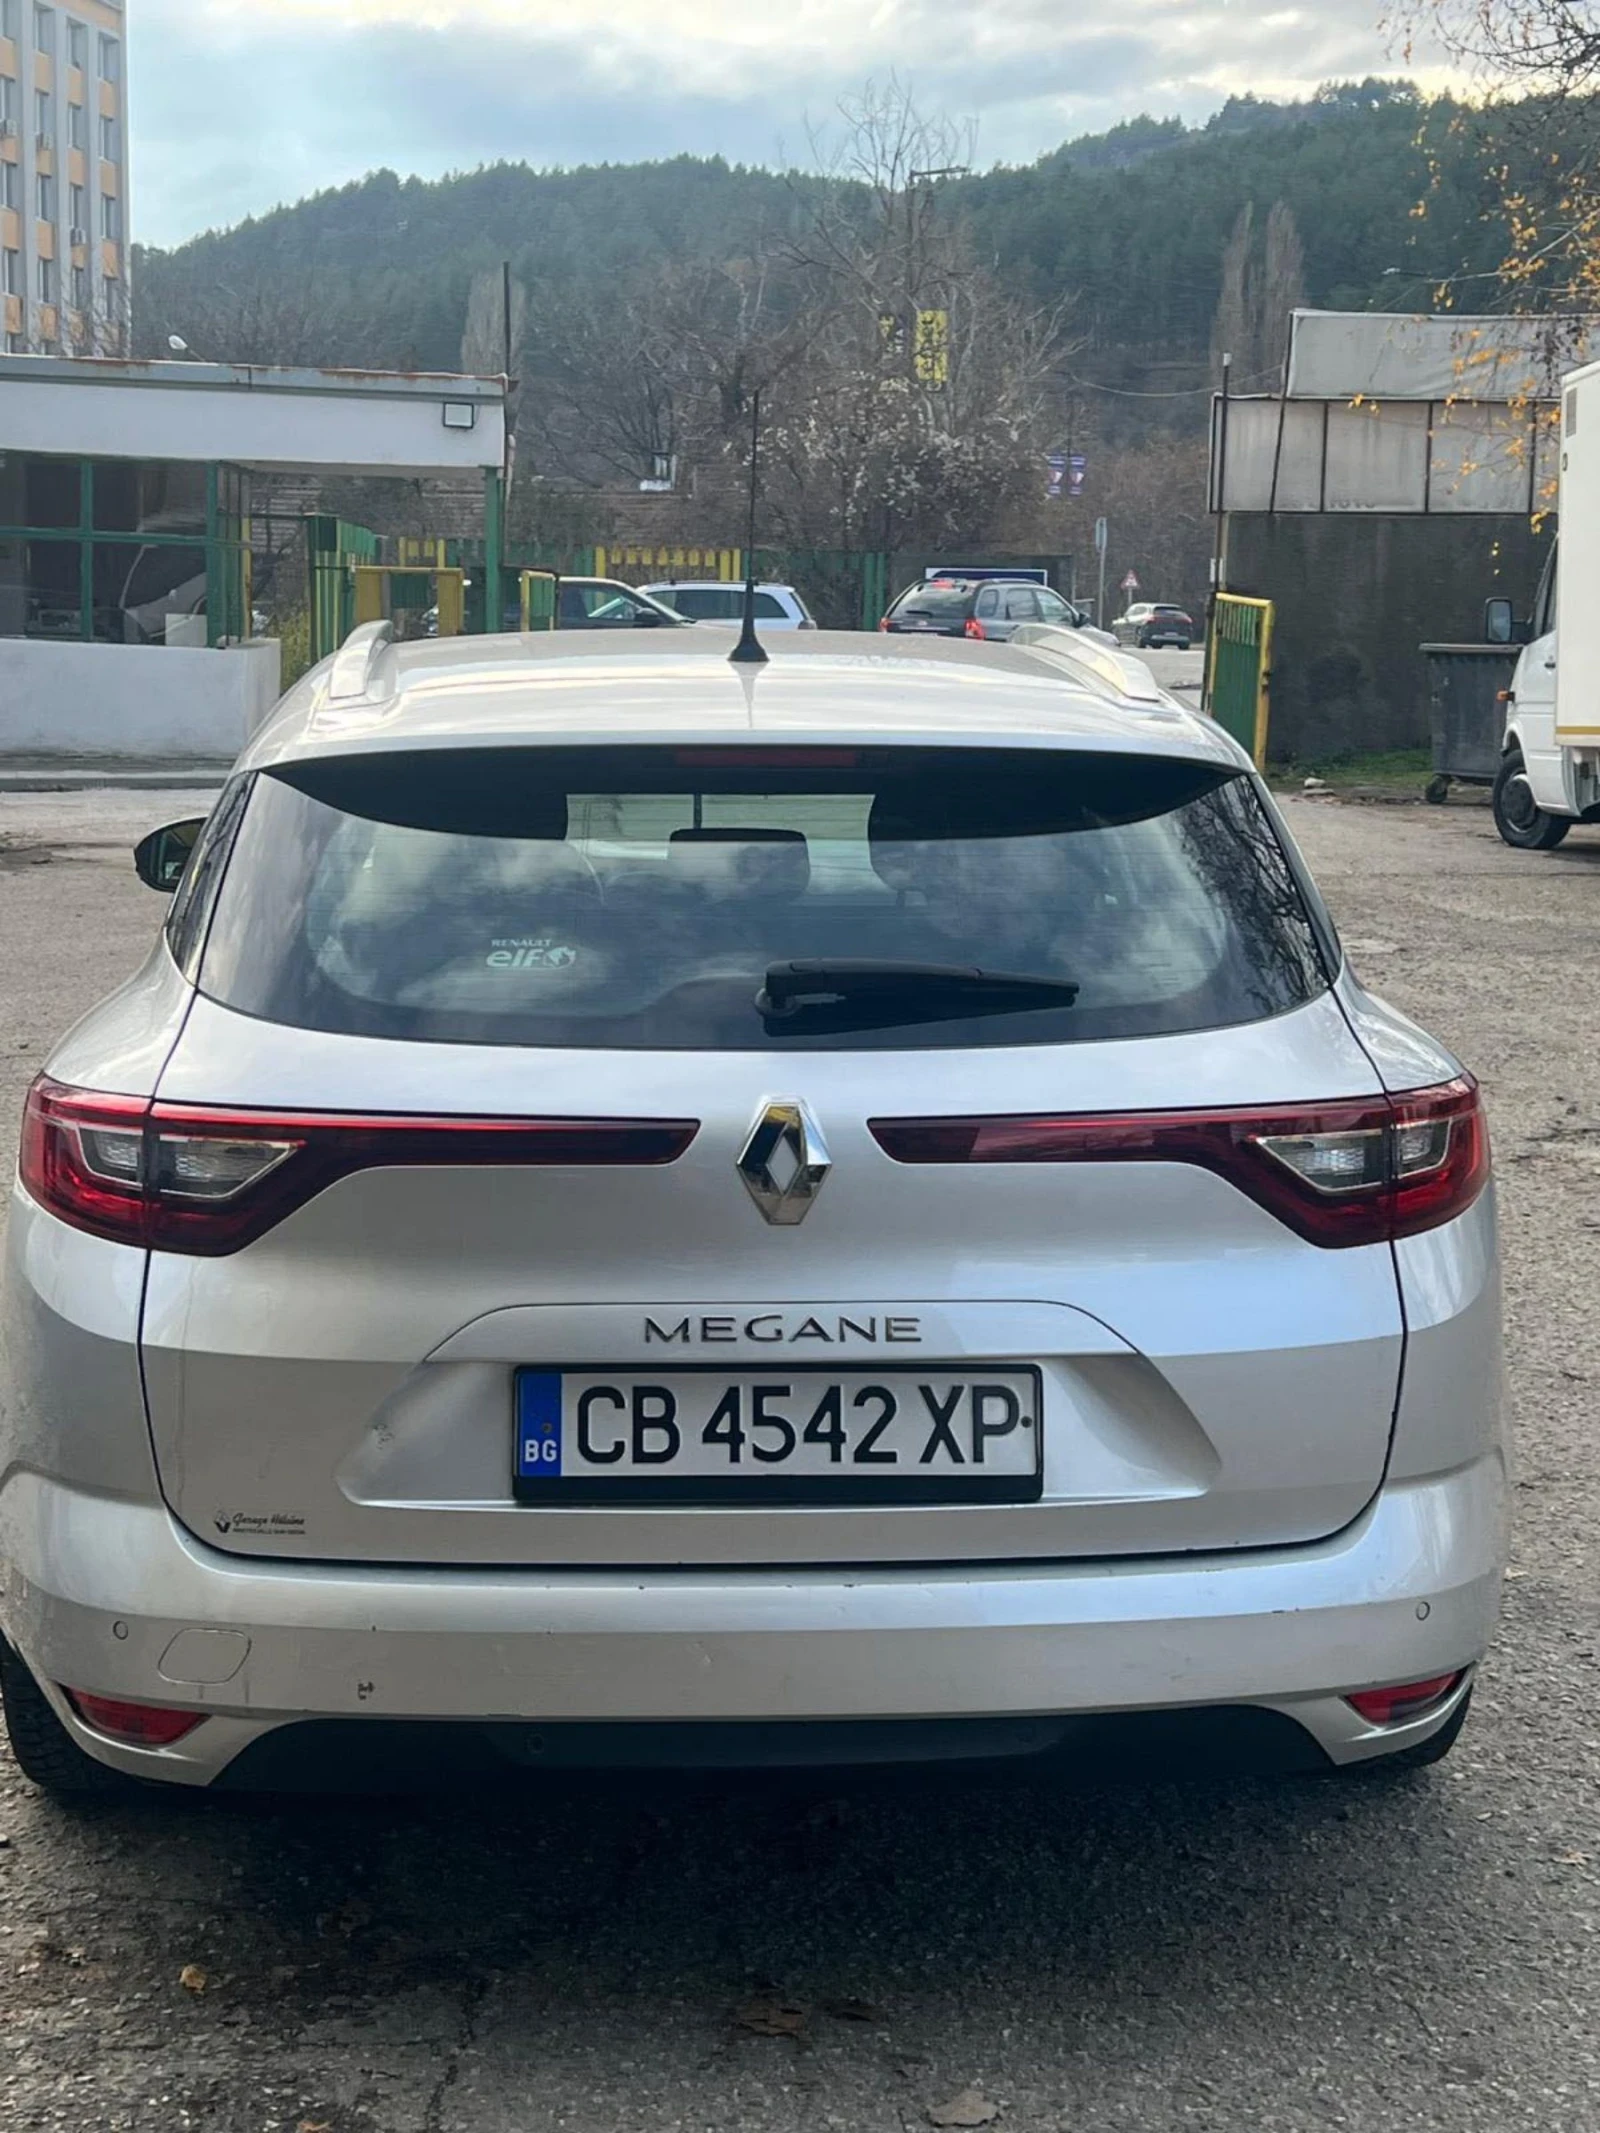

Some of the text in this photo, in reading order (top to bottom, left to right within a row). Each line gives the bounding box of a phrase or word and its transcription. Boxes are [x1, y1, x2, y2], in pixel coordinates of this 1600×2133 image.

[491, 939, 552, 947] RENAULT
[486, 948, 544, 968] elf
[644, 1315, 922, 1343] MEGANE
[577, 1385, 1020, 1465] CB 4542 XP
[524, 1439, 558, 1463] BG
